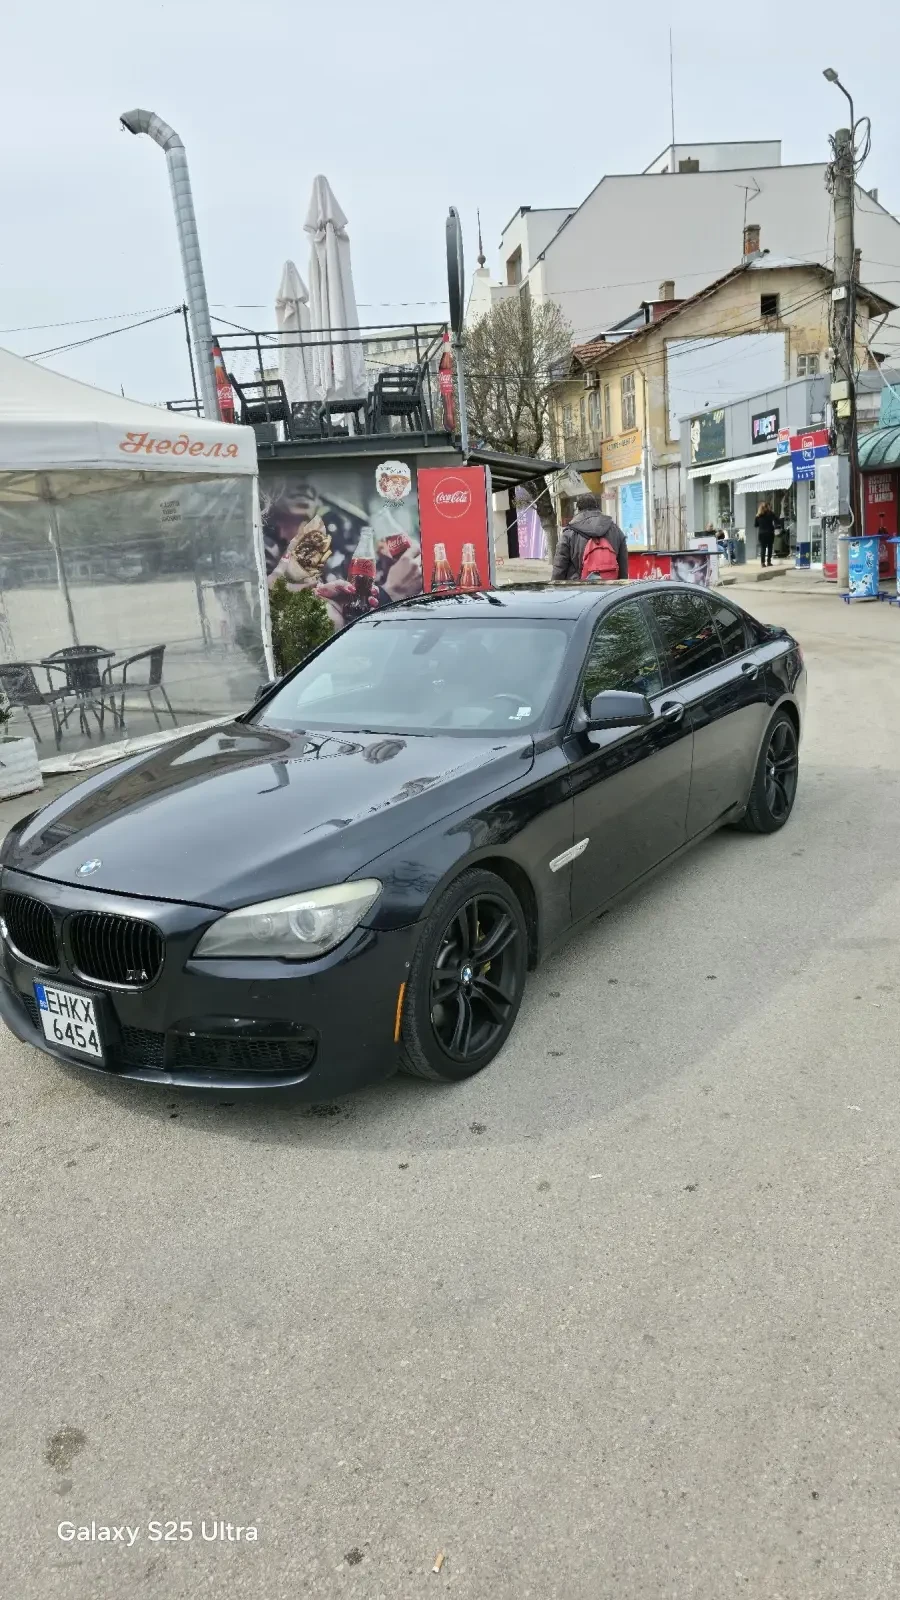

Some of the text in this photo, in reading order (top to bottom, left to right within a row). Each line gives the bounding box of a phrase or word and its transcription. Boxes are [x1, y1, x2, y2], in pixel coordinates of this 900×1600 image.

[119, 431, 239, 458] Неделя
[436, 490, 468, 504] Coca-Cola
[45, 989, 94, 1025] EHKX
[53, 1018, 98, 1053] 6454
